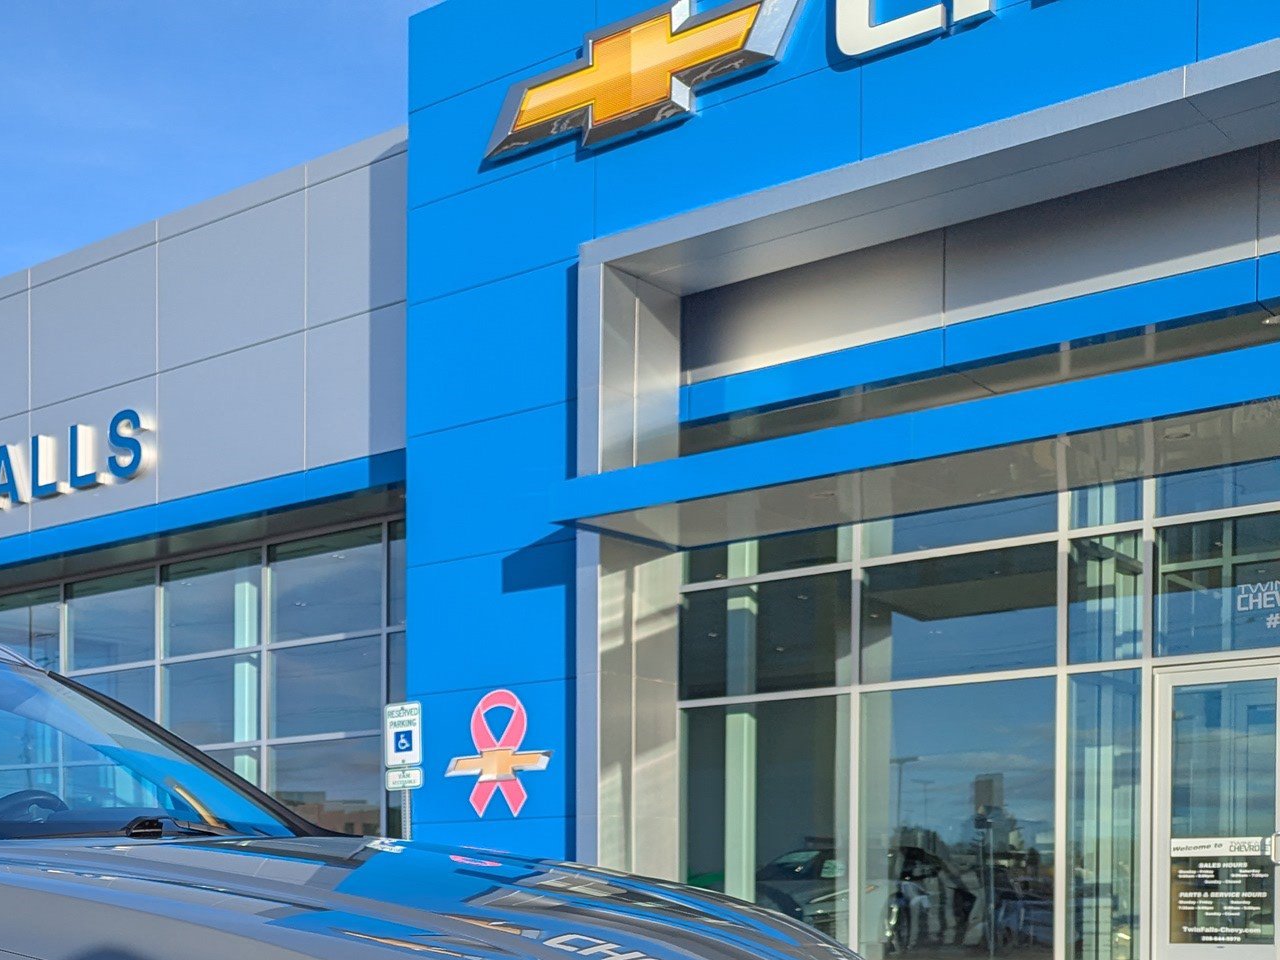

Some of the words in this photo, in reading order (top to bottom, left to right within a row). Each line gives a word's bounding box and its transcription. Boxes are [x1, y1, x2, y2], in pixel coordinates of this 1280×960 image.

[387, 707, 419, 719] RESERVED
[389, 719, 417, 729] PARKING
[1173, 844, 1211, 852] Welcome
